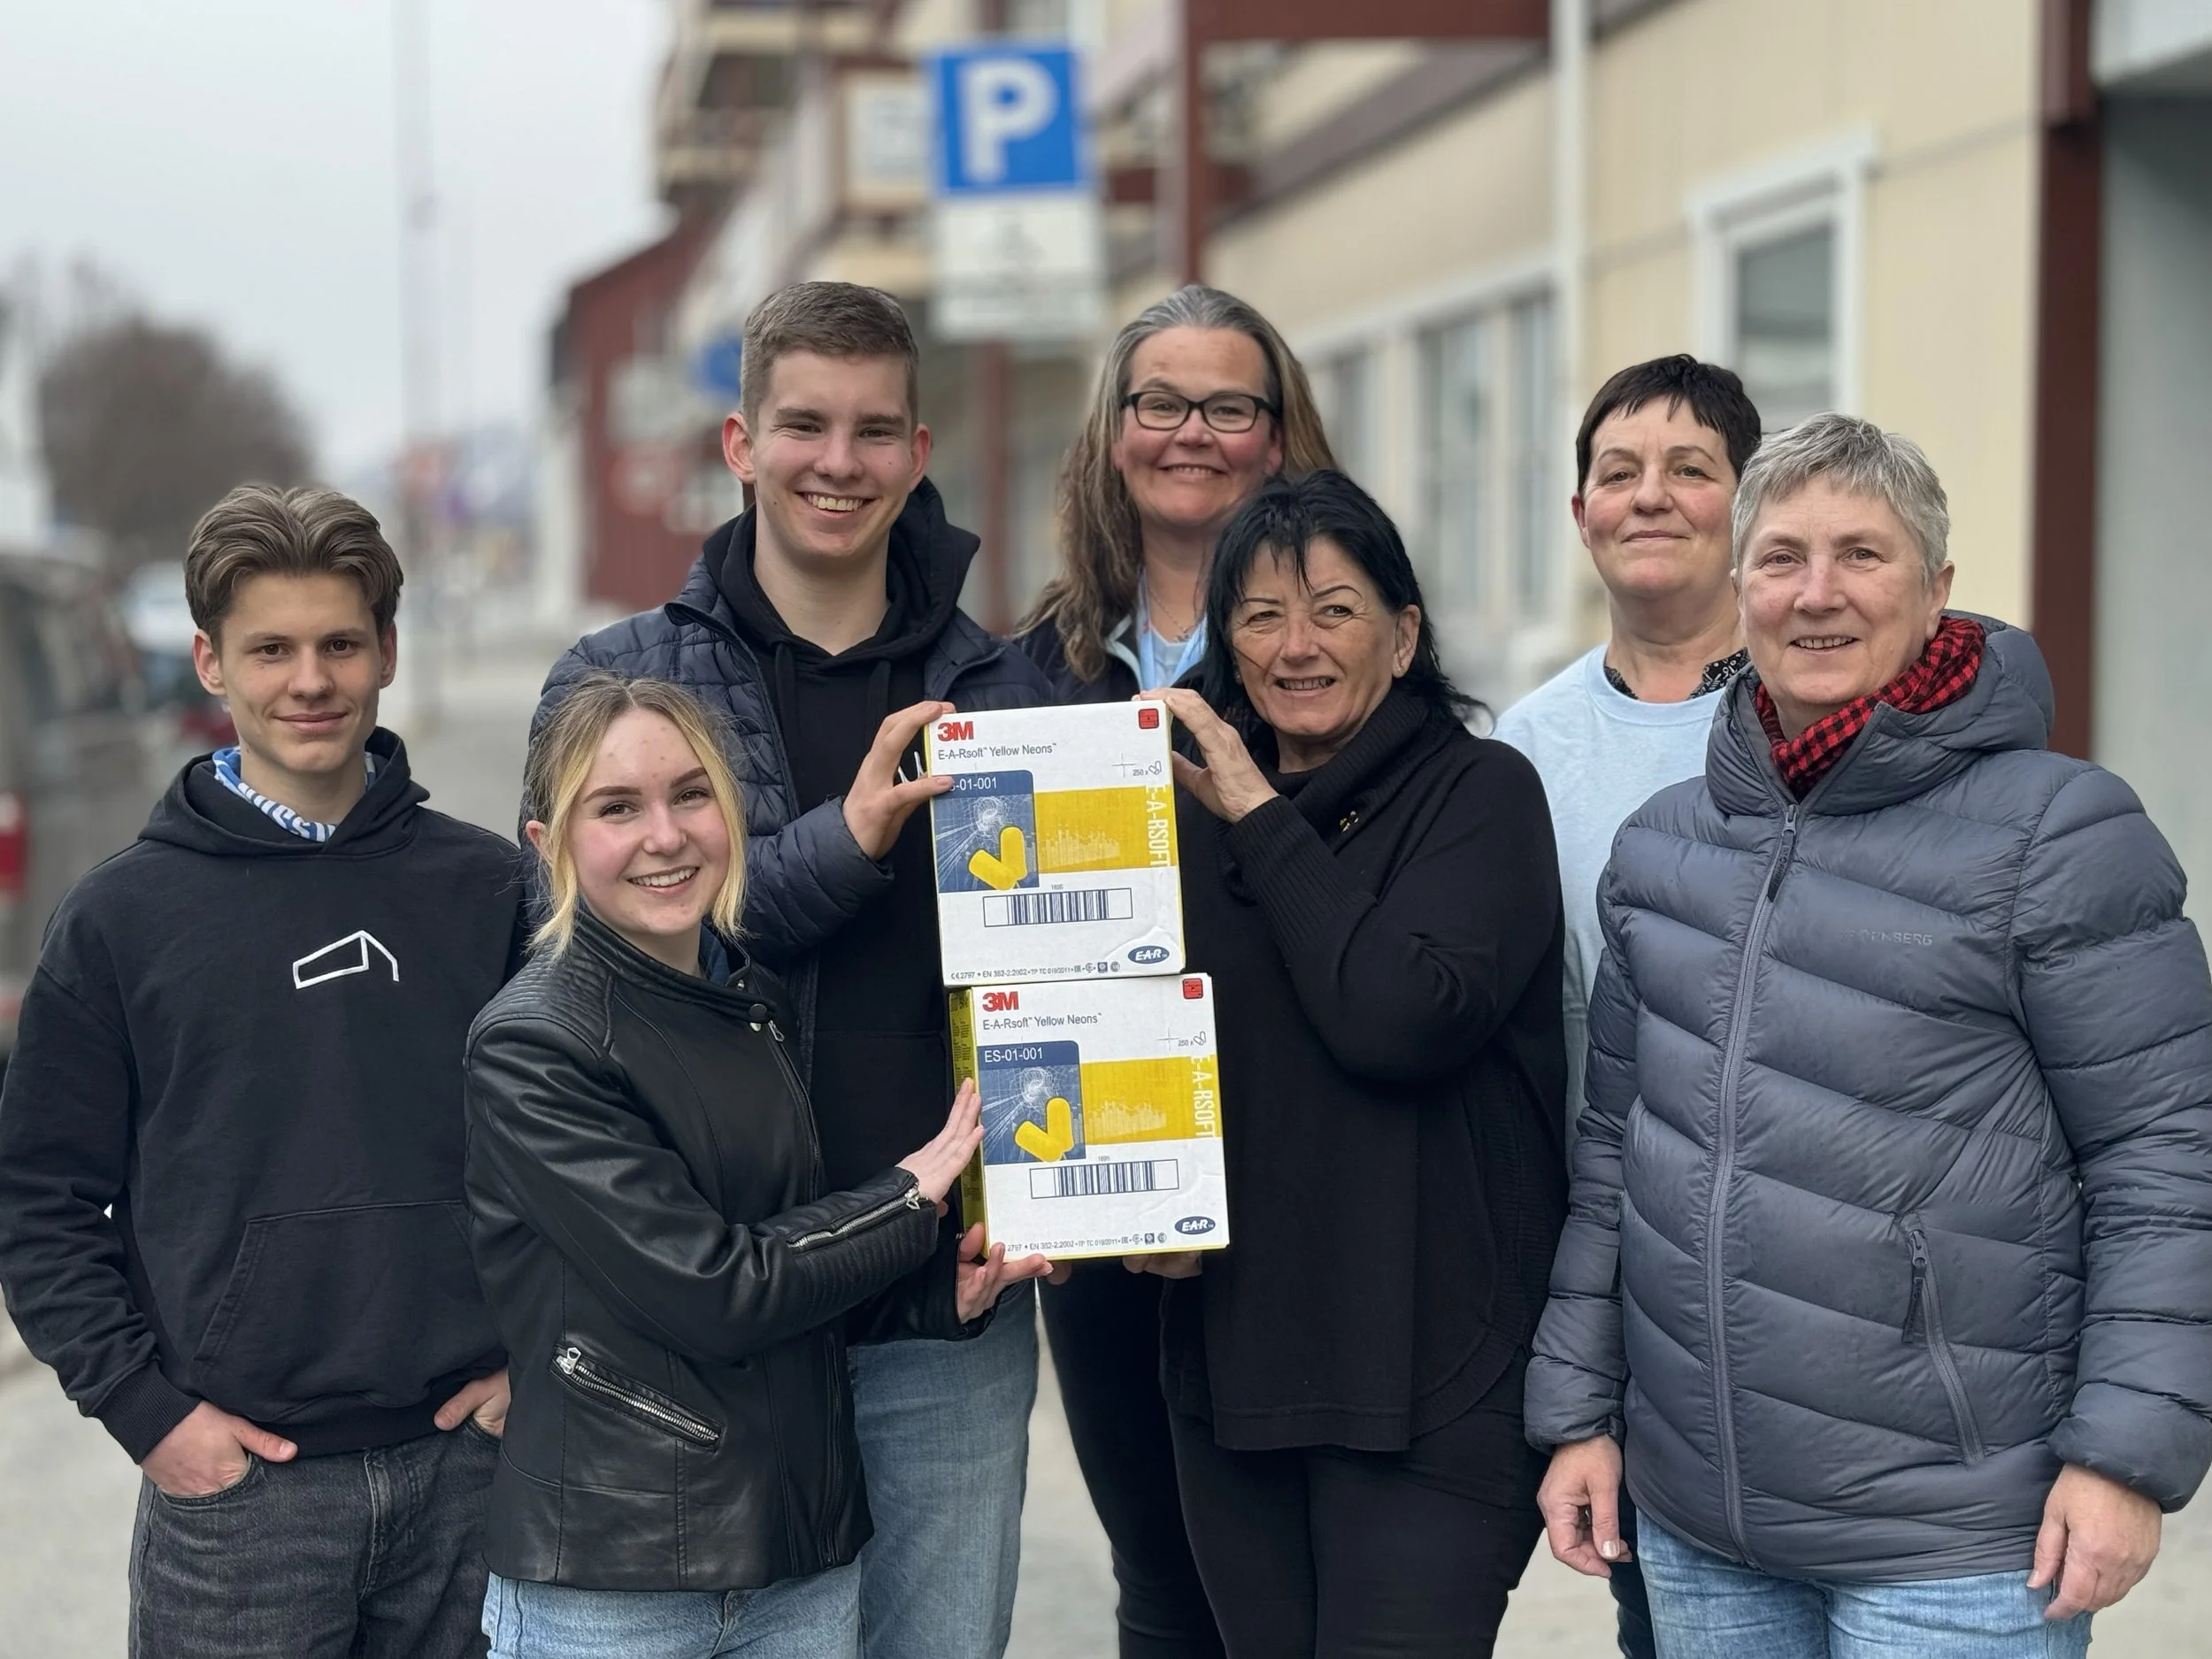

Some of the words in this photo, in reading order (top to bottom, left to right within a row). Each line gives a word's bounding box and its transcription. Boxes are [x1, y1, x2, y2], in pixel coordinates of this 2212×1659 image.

[960, 60, 1058, 181] P
[938, 721, 974, 741] 3M
[989, 745, 1019, 757] Yellow
[949, 777, 997, 792] -01-001
[982, 991, 1019, 1012] 3M
[1034, 1015, 1064, 1027] Yellow
[984, 1047, 1043, 1063] ES-01-001
